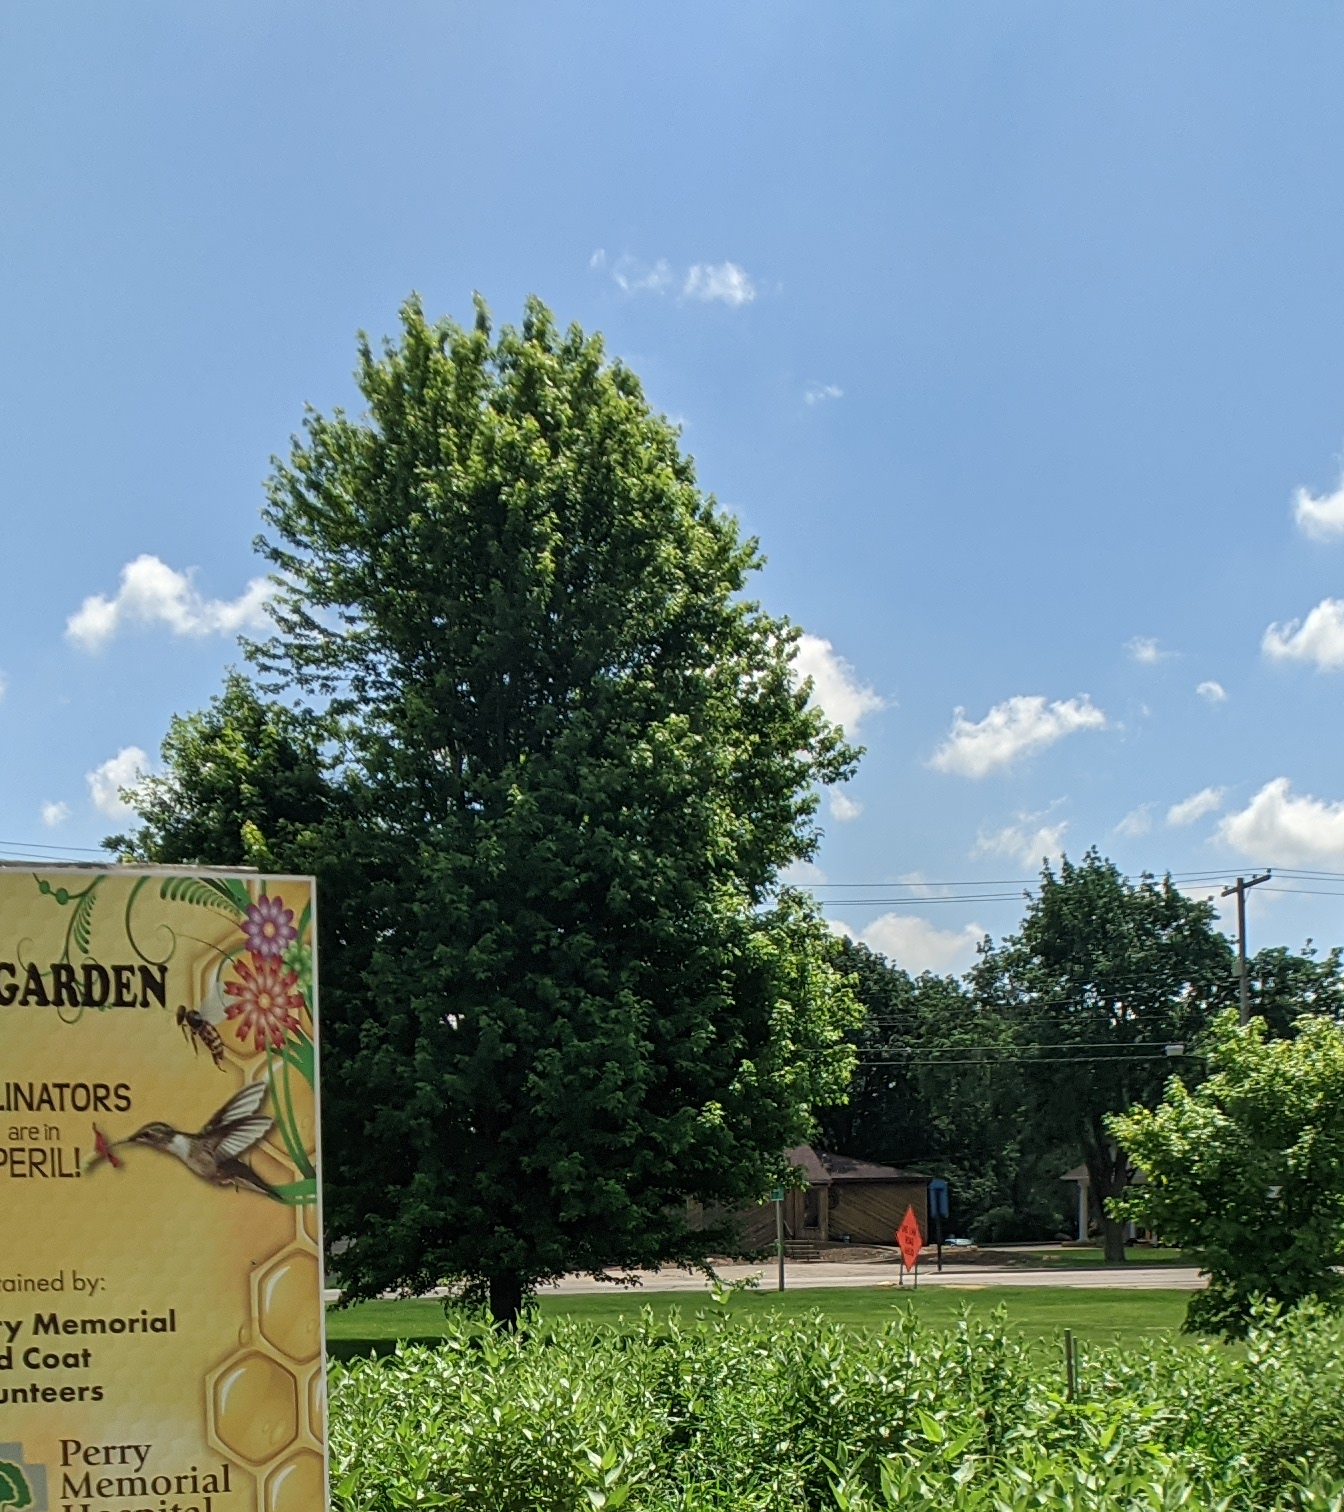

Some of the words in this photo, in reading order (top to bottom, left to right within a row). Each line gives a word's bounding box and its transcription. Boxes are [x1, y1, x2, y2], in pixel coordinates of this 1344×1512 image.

[8, 1125, 40, 1141] are
[44, 1123, 60, 1141] in
[72, 1269, 107, 1297] by:
[31, 1308, 178, 1337] Memorial
[22, 1346, 93, 1370] Coat
[58, 1439, 153, 1473] Perry
[58, 1463, 233, 1500] Memorial
